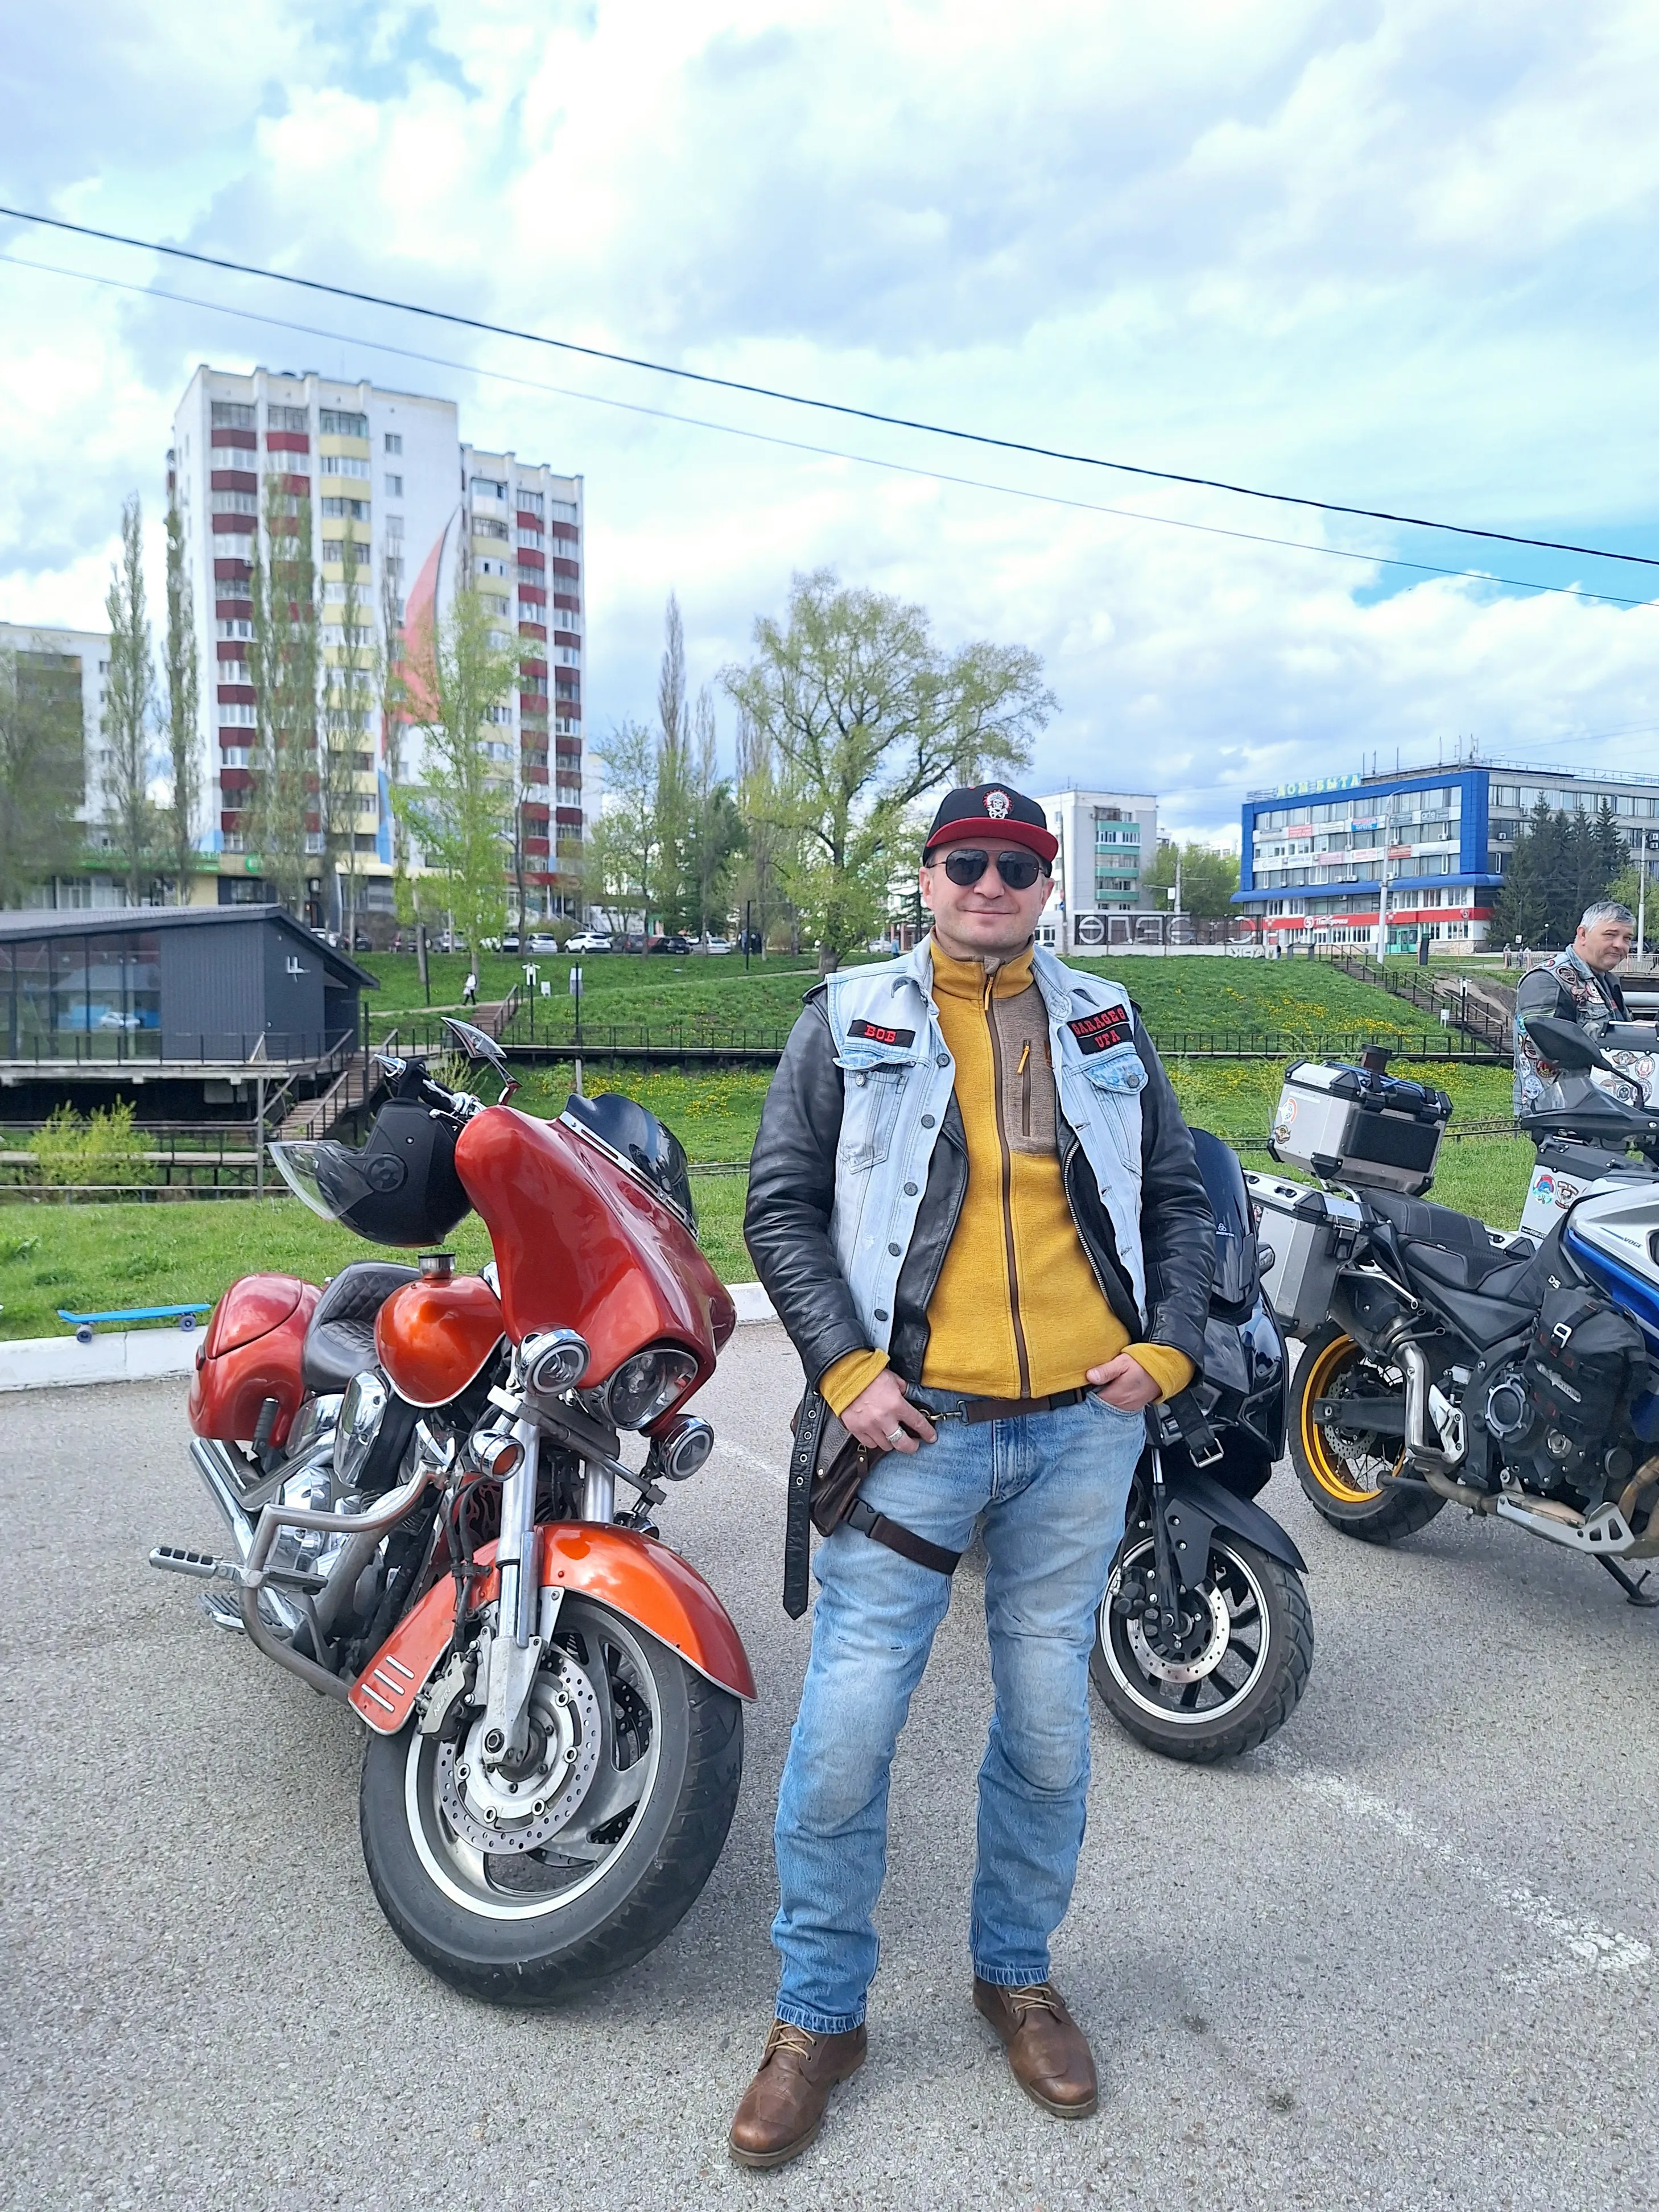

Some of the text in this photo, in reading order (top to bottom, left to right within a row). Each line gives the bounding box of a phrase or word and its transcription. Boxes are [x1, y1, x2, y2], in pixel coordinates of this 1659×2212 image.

[1277, 774, 1360, 798] ДОМ БЫТА
[864, 1025, 897, 1042] BOB
[1094, 1030, 1121, 1048] UFA
[1623, 1237, 1643, 1249] VOGE
[1547, 1274, 1561, 1289] DS
